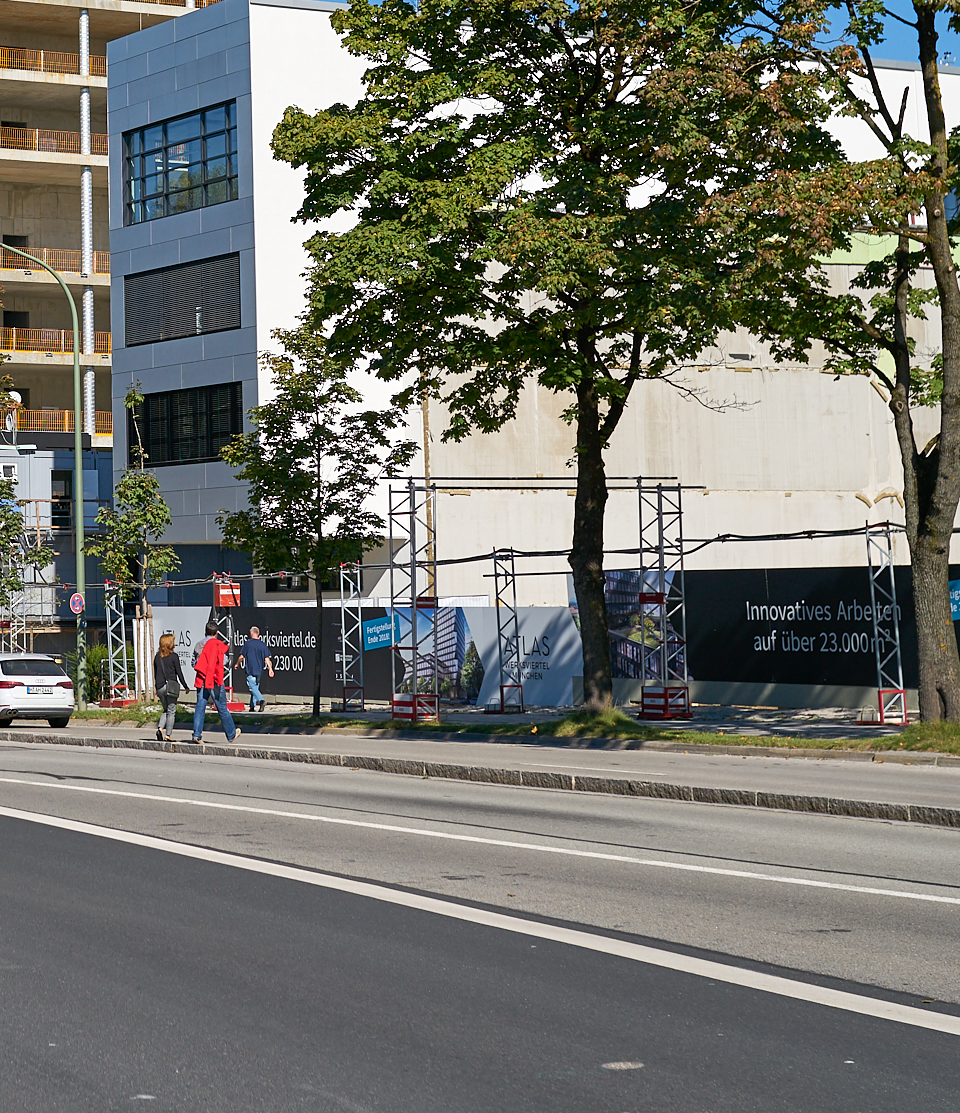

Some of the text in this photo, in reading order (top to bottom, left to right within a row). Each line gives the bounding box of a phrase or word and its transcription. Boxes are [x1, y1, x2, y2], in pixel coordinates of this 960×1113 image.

[746, 599, 902, 622] Innovatives Arbeten
[366, 622, 397, 634] Fertigstellug
[753, 629, 777, 652] auf
[781, 630, 816, 653] über
[273, 655, 291, 671] 230
[291, 655, 304, 672] 00
[512, 671, 543, 680] MNCHEN
